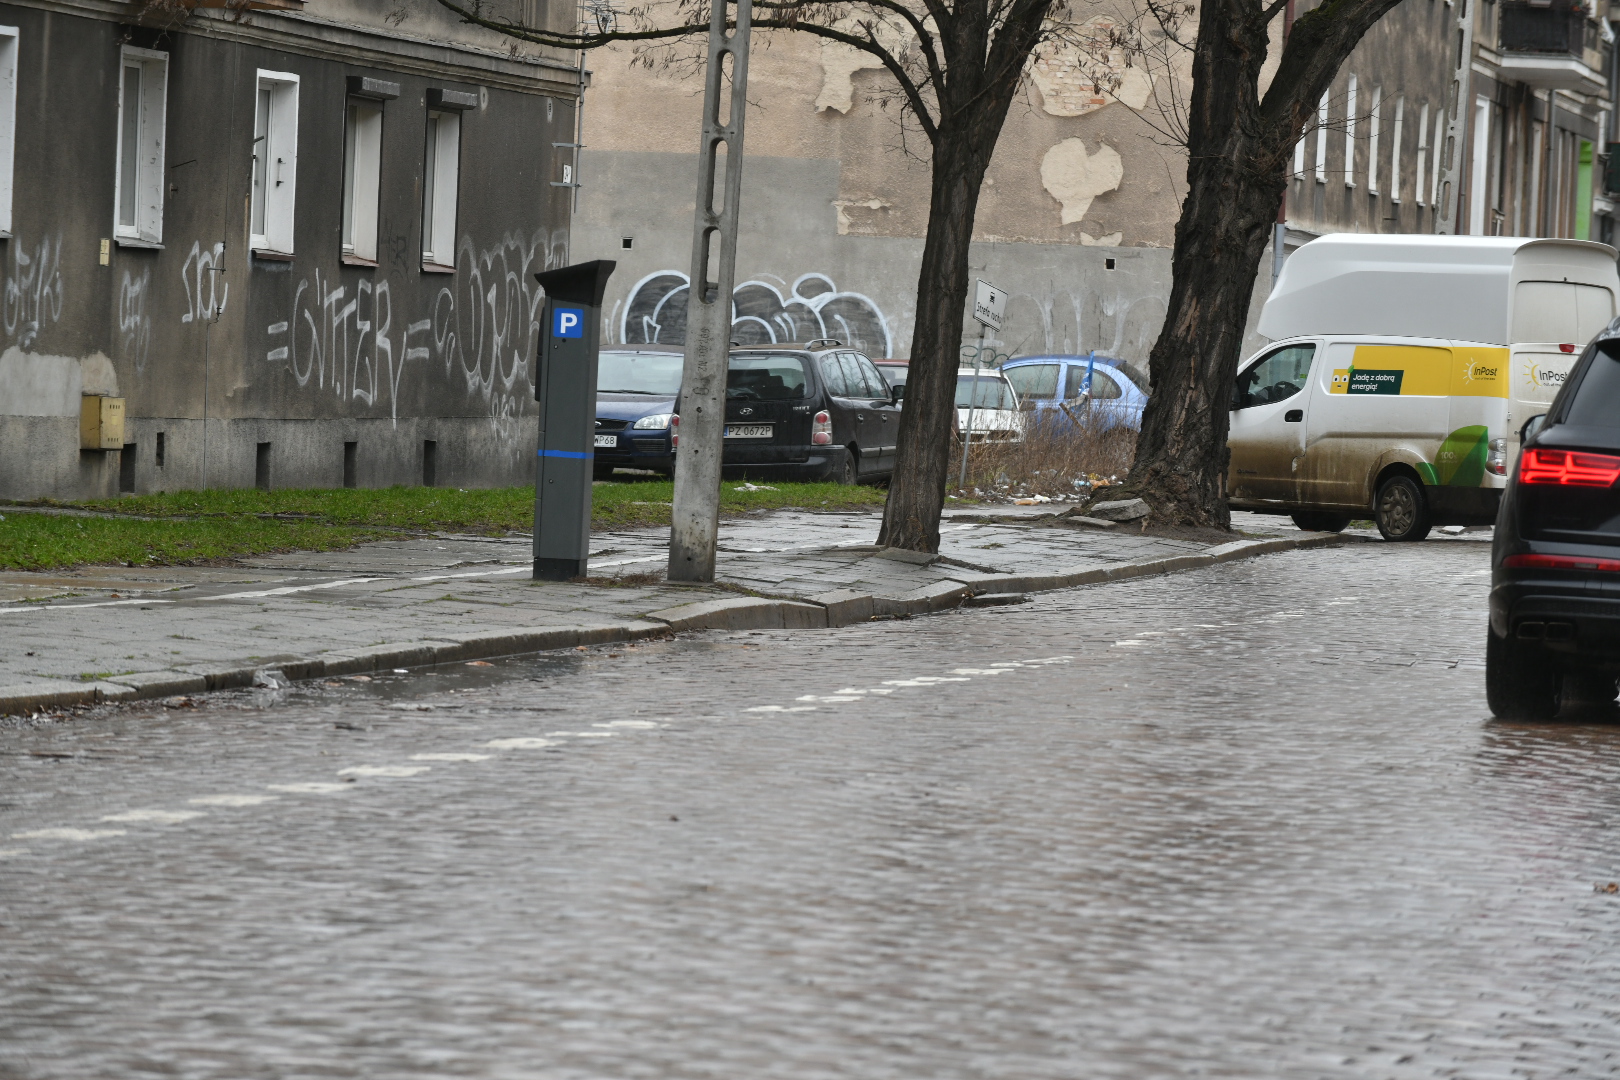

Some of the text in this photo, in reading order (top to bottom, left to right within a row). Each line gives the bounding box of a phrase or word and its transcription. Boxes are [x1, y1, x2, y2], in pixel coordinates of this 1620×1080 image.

[560, 312, 577, 334] P
[1473, 366, 1498, 377] InPost
[1352, 373, 1370, 382] Jadę
[1375, 374, 1395, 382] dobrą
[1351, 383, 1378, 391] energią!
[728, 426, 771, 436] PZ 0672P
